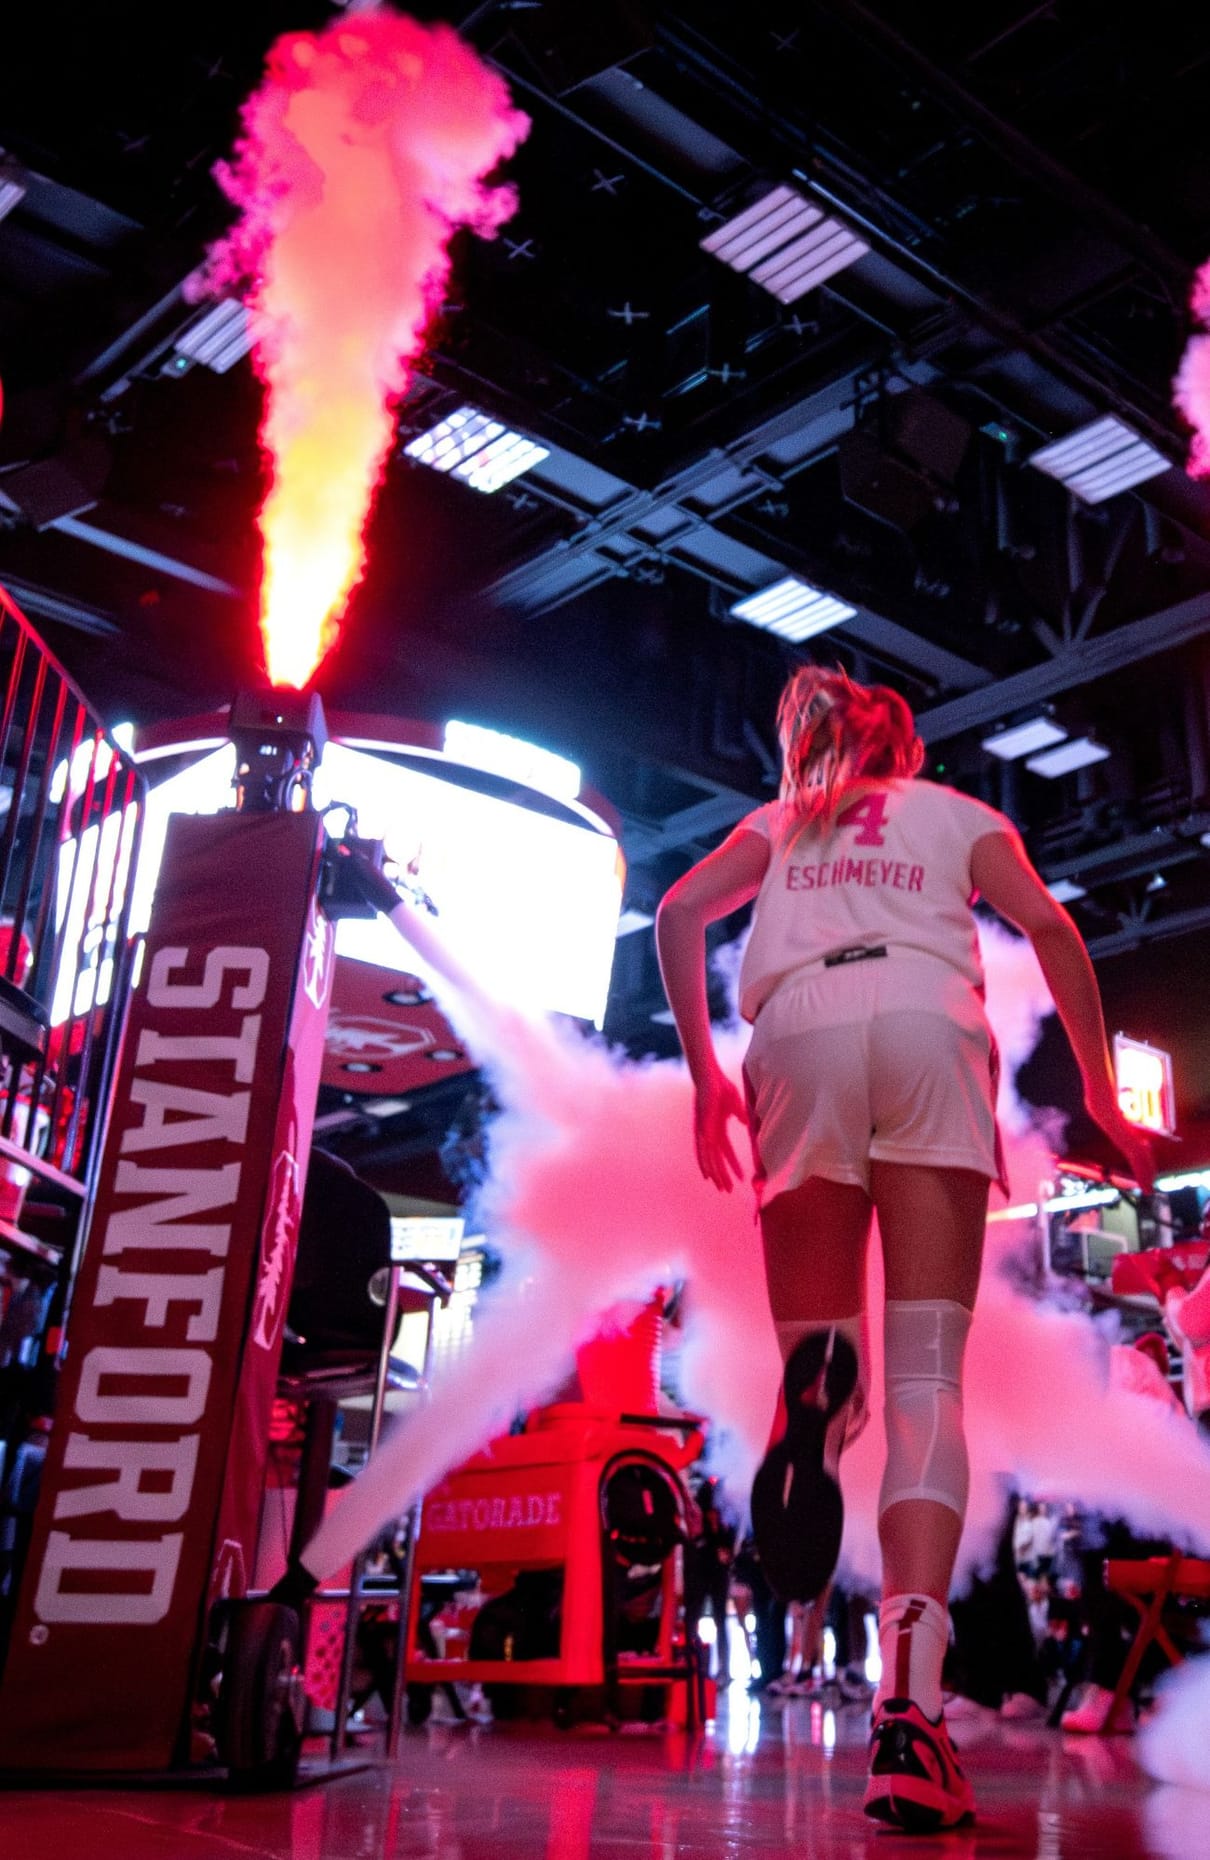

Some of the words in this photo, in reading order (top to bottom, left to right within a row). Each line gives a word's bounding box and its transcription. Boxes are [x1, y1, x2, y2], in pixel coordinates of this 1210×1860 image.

[836, 793, 888, 846] 4
[786, 859, 925, 892] ESCHMEYER
[34, 946, 270, 1624] STANFORD
[428, 1493, 562, 1531] GATORADE
